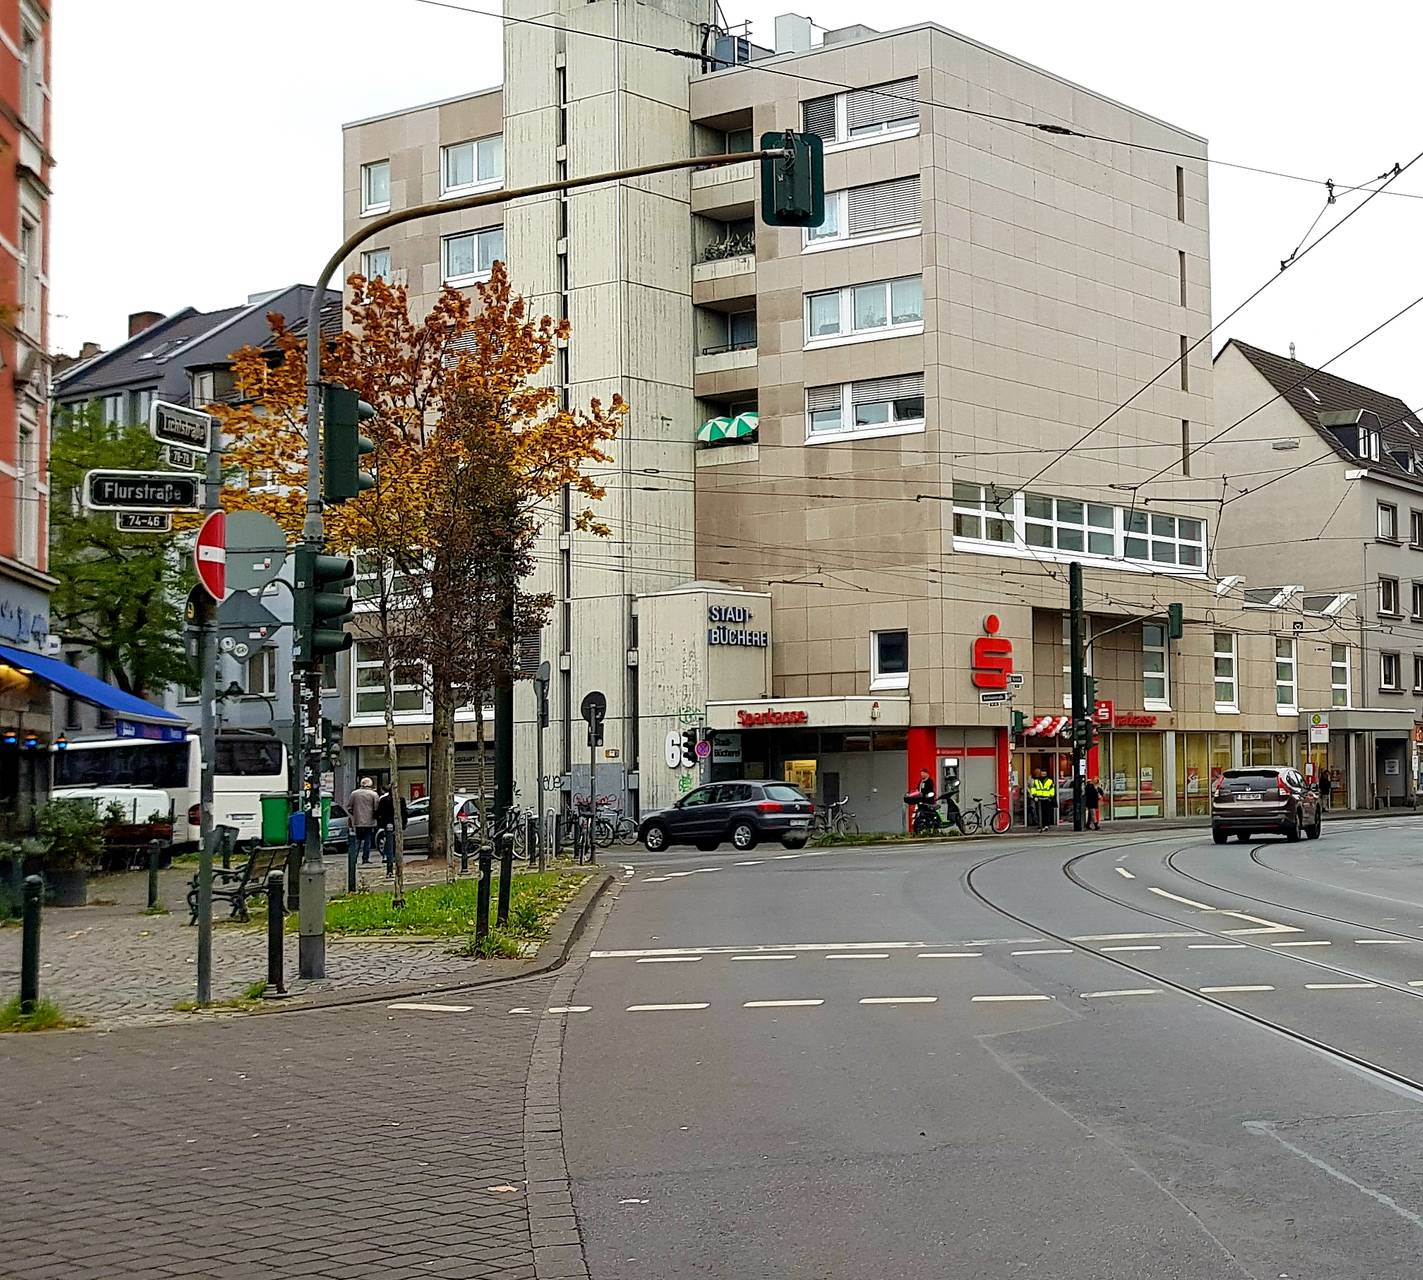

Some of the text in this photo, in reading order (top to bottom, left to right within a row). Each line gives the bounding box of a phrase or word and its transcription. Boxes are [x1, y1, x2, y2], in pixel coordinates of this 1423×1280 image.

[104, 482, 182, 502] Flurstraße
[128, 515, 161, 526] 74-46
[737, 708, 809, 727] Sparkasse
